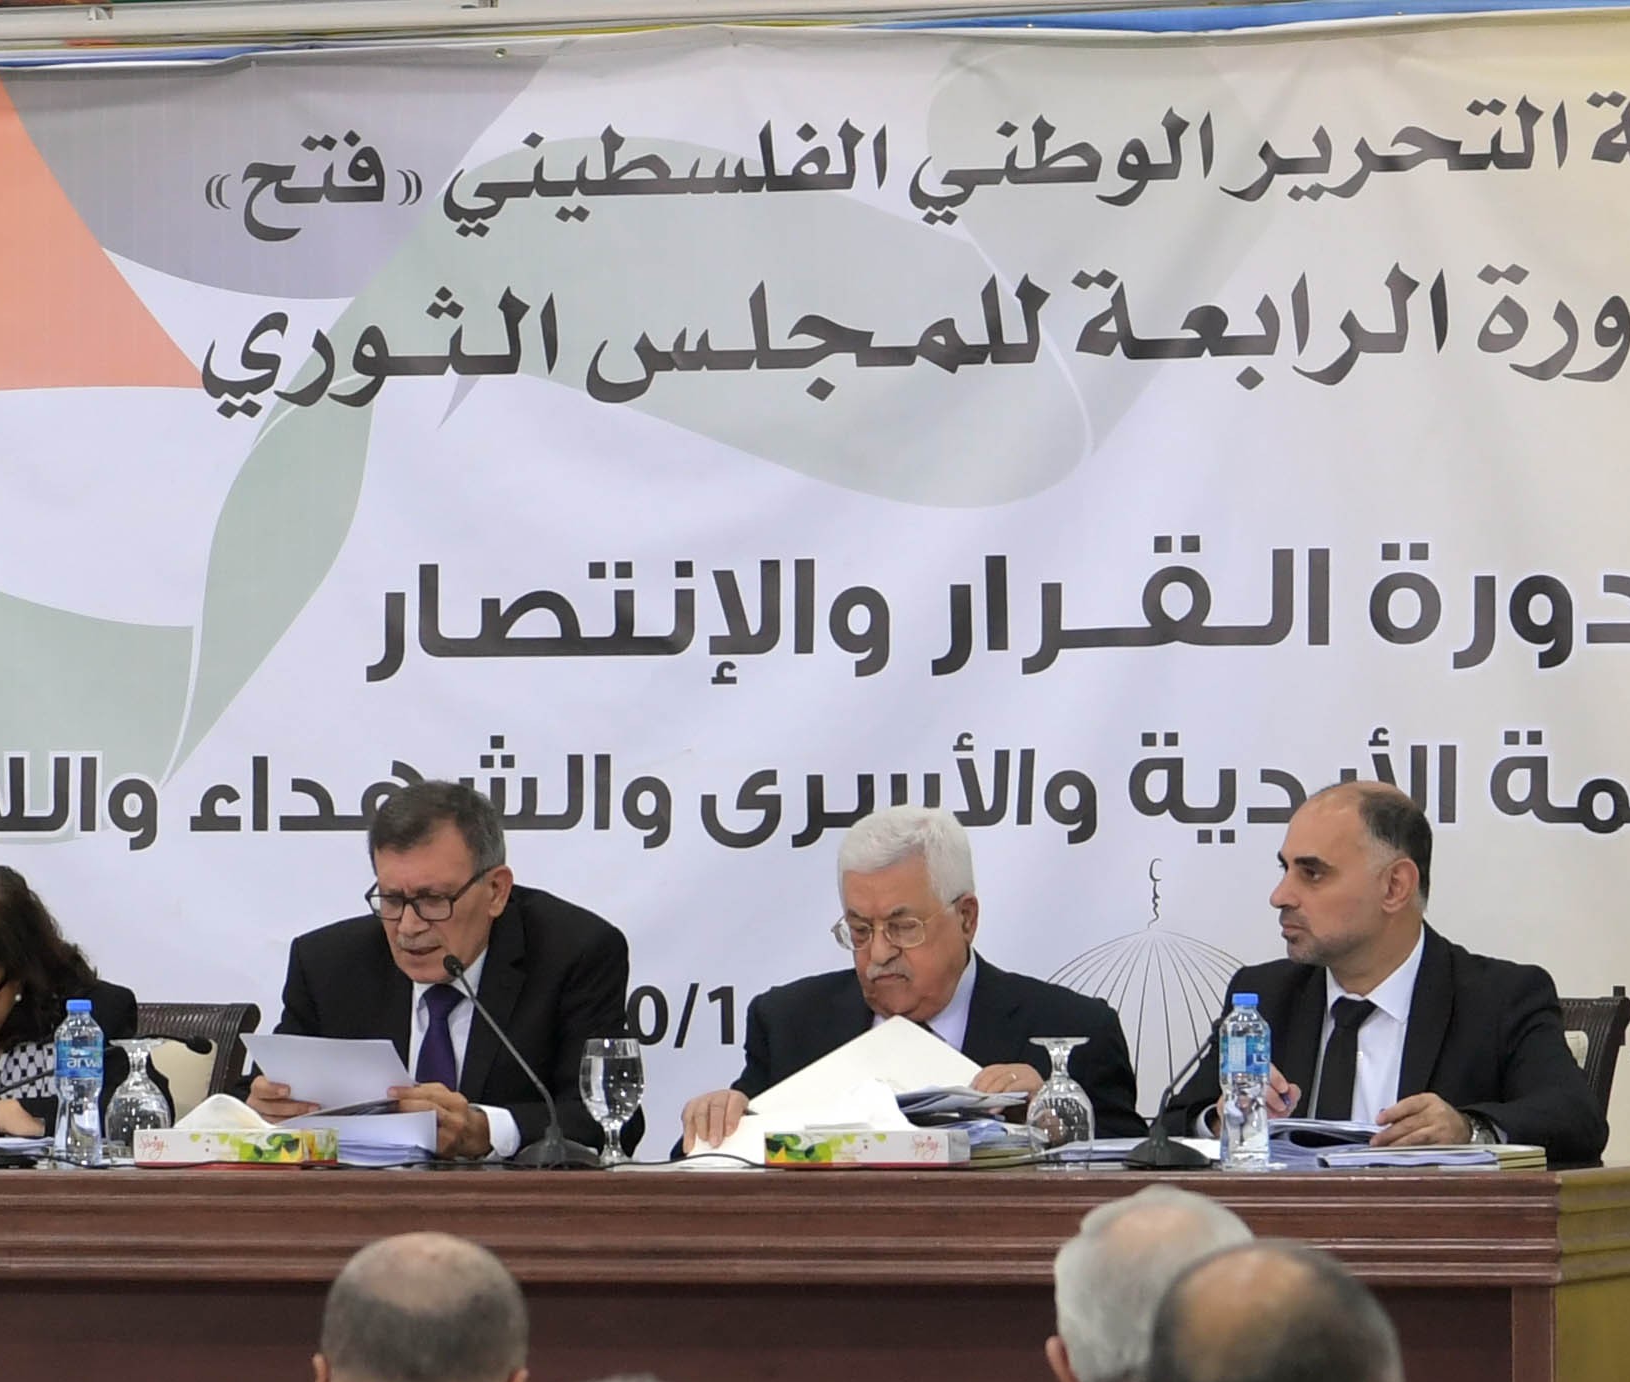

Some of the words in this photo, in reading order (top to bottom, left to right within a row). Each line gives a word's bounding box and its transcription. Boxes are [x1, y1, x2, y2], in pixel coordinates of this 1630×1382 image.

[443, 119, 887, 238] الفلسطيني
[909, 108, 1214, 225] الوطني
[1219, 94, 1569, 202] التحرير
[201, 286, 559, 419] الثوري
[586, 273, 1051, 403] للمجلس
[1071, 261, 1448, 391] الرابعة
[366, 557, 891, 686] والإنتصار
[931, 535, 1331, 676] القرار
[699, 731, 1098, 849] والأسرى
